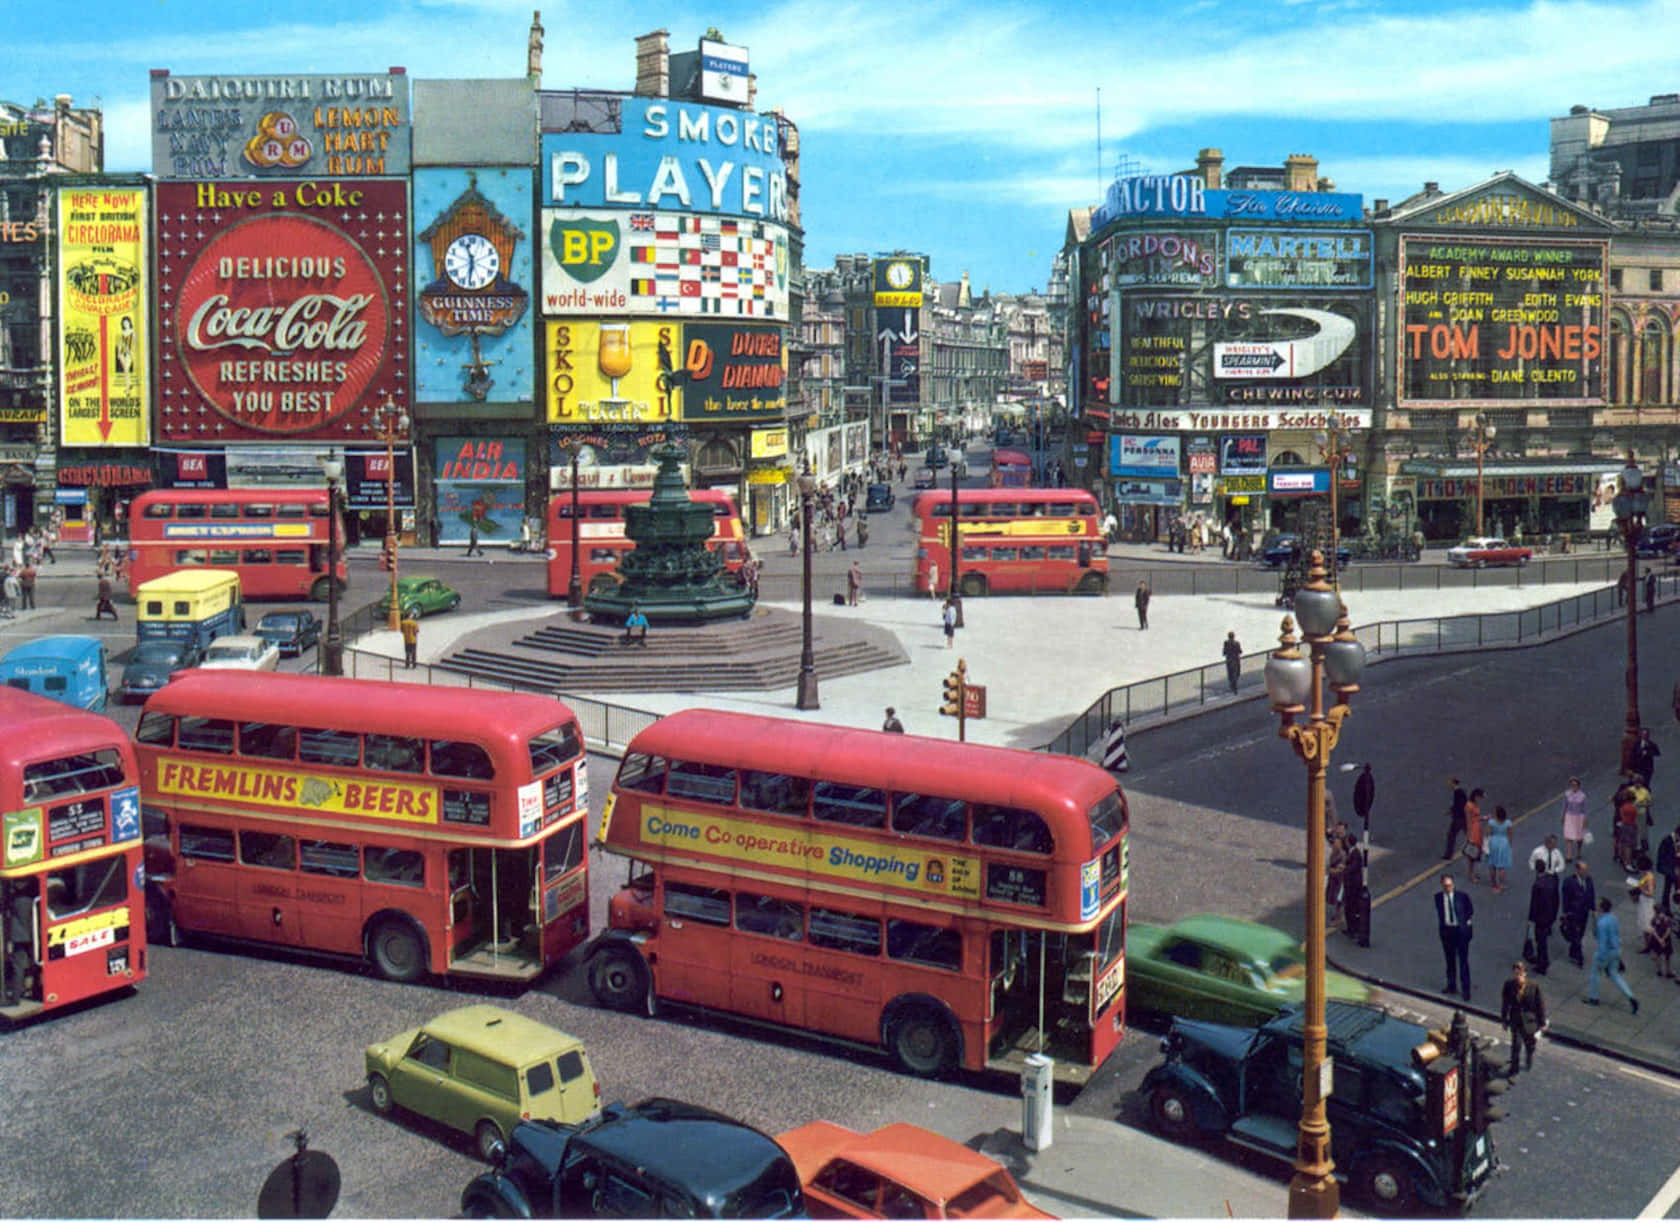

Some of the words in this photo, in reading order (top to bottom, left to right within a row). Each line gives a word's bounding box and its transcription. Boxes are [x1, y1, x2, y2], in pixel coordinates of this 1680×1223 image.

[166, 79, 310, 99] DAIQUIRI
[324, 78, 393, 99] RUM
[314, 107, 399, 128] LEMON
[645, 105, 774, 153] SMOKE
[324, 131, 391, 153] HART
[328, 155, 386, 176] RUM
[197, 183, 261, 208] Have
[272, 190, 287, 208] a
[296, 182, 363, 208] Coke
[562, 229, 615, 265] BP
[1231, 236, 1369, 258] MARTELL
[1430, 247, 1486, 261] ACADEMY
[1490, 248, 1529, 262] AWARD
[1533, 250, 1573, 263] WINNER
[219, 257, 346, 279] DELICIOUS
[1406, 265, 1451, 279] ALBERT
[1459, 266, 1499, 280] FINNEY
[1506, 267, 1565, 281] SUSANNAH
[1571, 269, 1601, 282] YORK
[432, 296, 513, 309] GUINNESS
[547, 288, 626, 308] world-wide
[1406, 291, 1438, 304] HUGH
[1443, 292, 1494, 305] GRIFFITH
[1524, 293, 1557, 306] EDITH
[1565, 294, 1601, 307] EVANS
[187, 293, 375, 350] Coca-Cola
[455, 309, 492, 321] TIME
[1451, 309, 1484, 321] JOAN
[1491, 309, 1559, 322] GREENWOOD
[1406, 324, 1479, 360] TOM
[1497, 325, 1600, 361] JONES
[1224, 355, 1276, 366] SPEARMINT
[220, 361, 347, 382] REFRESHES
[554, 326, 574, 417] SKOL
[1491, 370, 1525, 384] DIANE
[1531, 370, 1577, 384] CILENTO
[233, 392, 273, 412] YOU
[281, 391, 335, 412] BEST
[1230, 388, 1315, 400] CHEWING
[1322, 388, 1361, 400] GUM
[1144, 411, 1180, 428] Ales
[1189, 411, 1269, 429] YOUNGERS
[1278, 411, 1327, 429] Scotch
[457, 441, 504, 460] AIR
[442, 461, 518, 480] INDIA
[163, 763, 297, 802] FREMLINS
[344, 783, 431, 817] BEERS
[647, 816, 700, 839] Come
[829, 846, 919, 882] Shopping
